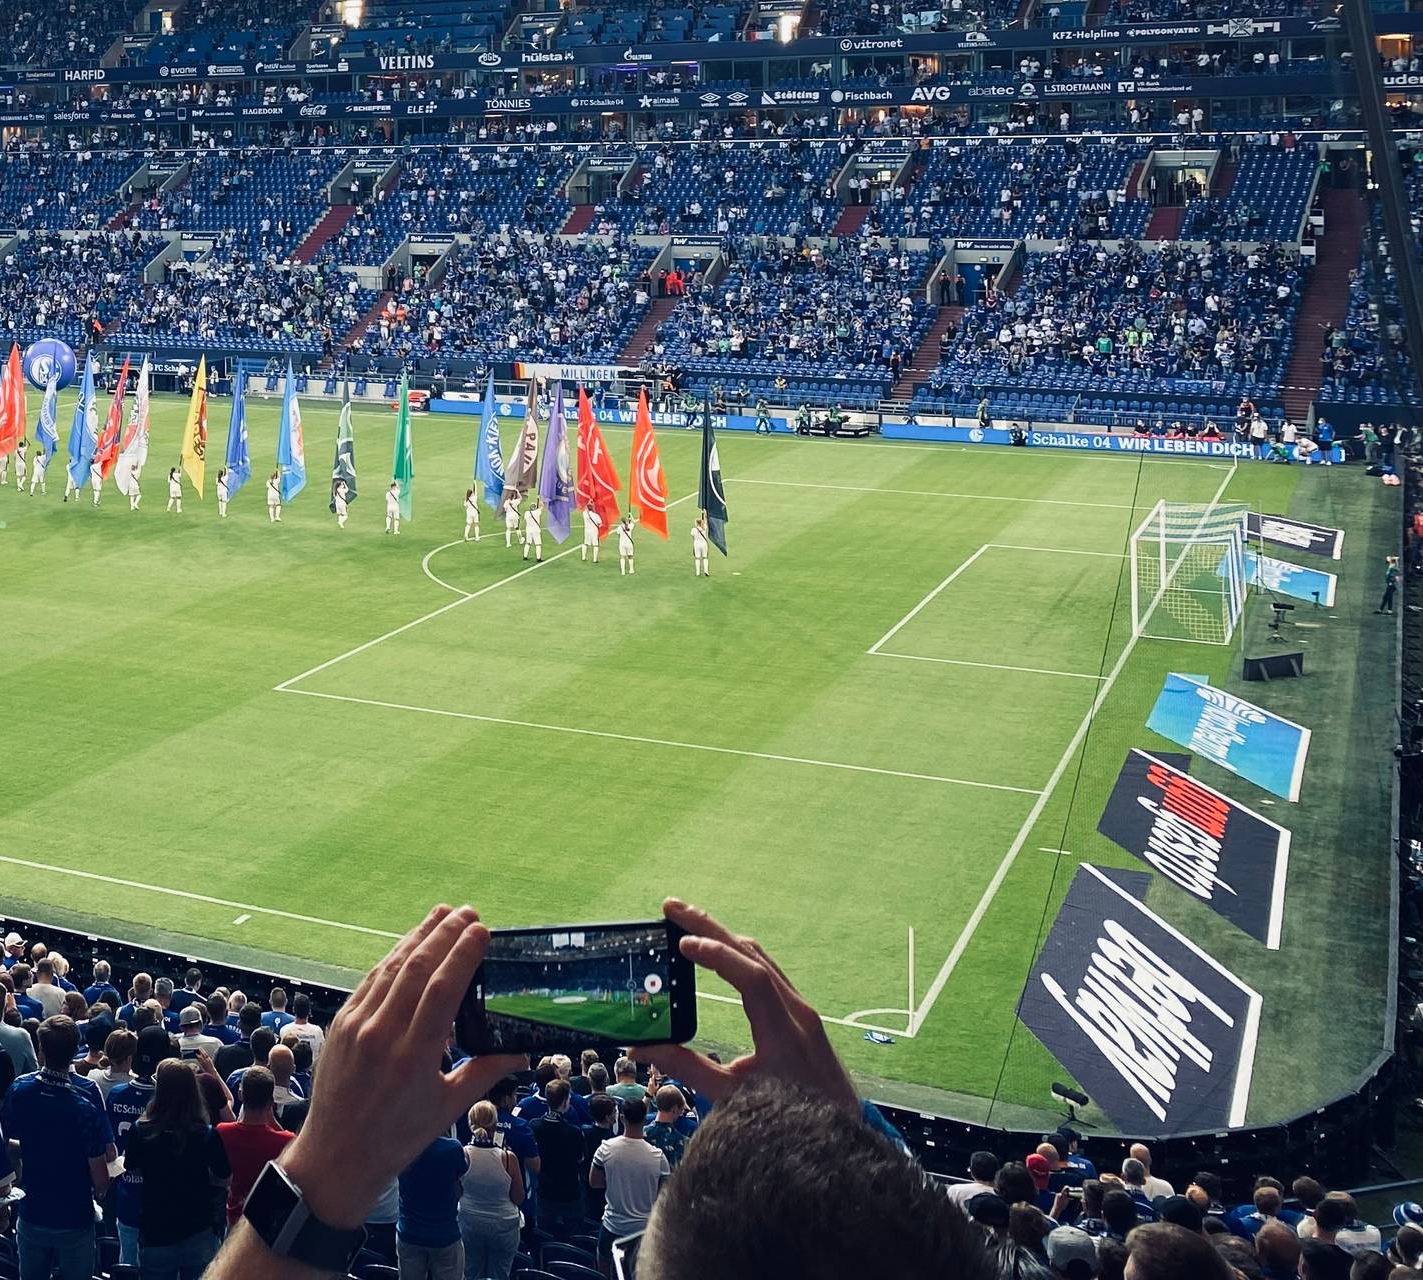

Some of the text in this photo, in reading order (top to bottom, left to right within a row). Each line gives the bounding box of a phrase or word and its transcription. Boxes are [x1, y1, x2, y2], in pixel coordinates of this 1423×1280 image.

[1052, 29, 1120, 40] KFZ-Helpline
[853, 38, 903, 49] vitronet
[522, 51, 563, 62] hülsta
[379, 54, 435, 71] VELTINS
[64, 69, 106, 81] HARFID
[774, 90, 820, 99] Stölting
[845, 91, 893, 101] Fischbach
[910, 86, 951, 101] AVG
[968, 85, 1015, 96] abatec
[485, 98, 531, 109] TÖNNIES
[589, 98, 615, 106] Schalke
[615, 98, 624, 106] 04
[242, 107, 283, 115] HAGEDORN
[407, 105, 425, 114] ELE
[53, 111, 90, 121] salesforce
[560, 367, 618, 380] MILLINGEN
[600, 410, 613, 421] 04
[1033, 432, 1254, 457] Schalke 04 WIR LEBEN DICH
[1040, 919, 1235, 1123] betway
[113, 1103, 123, 1114] FC
